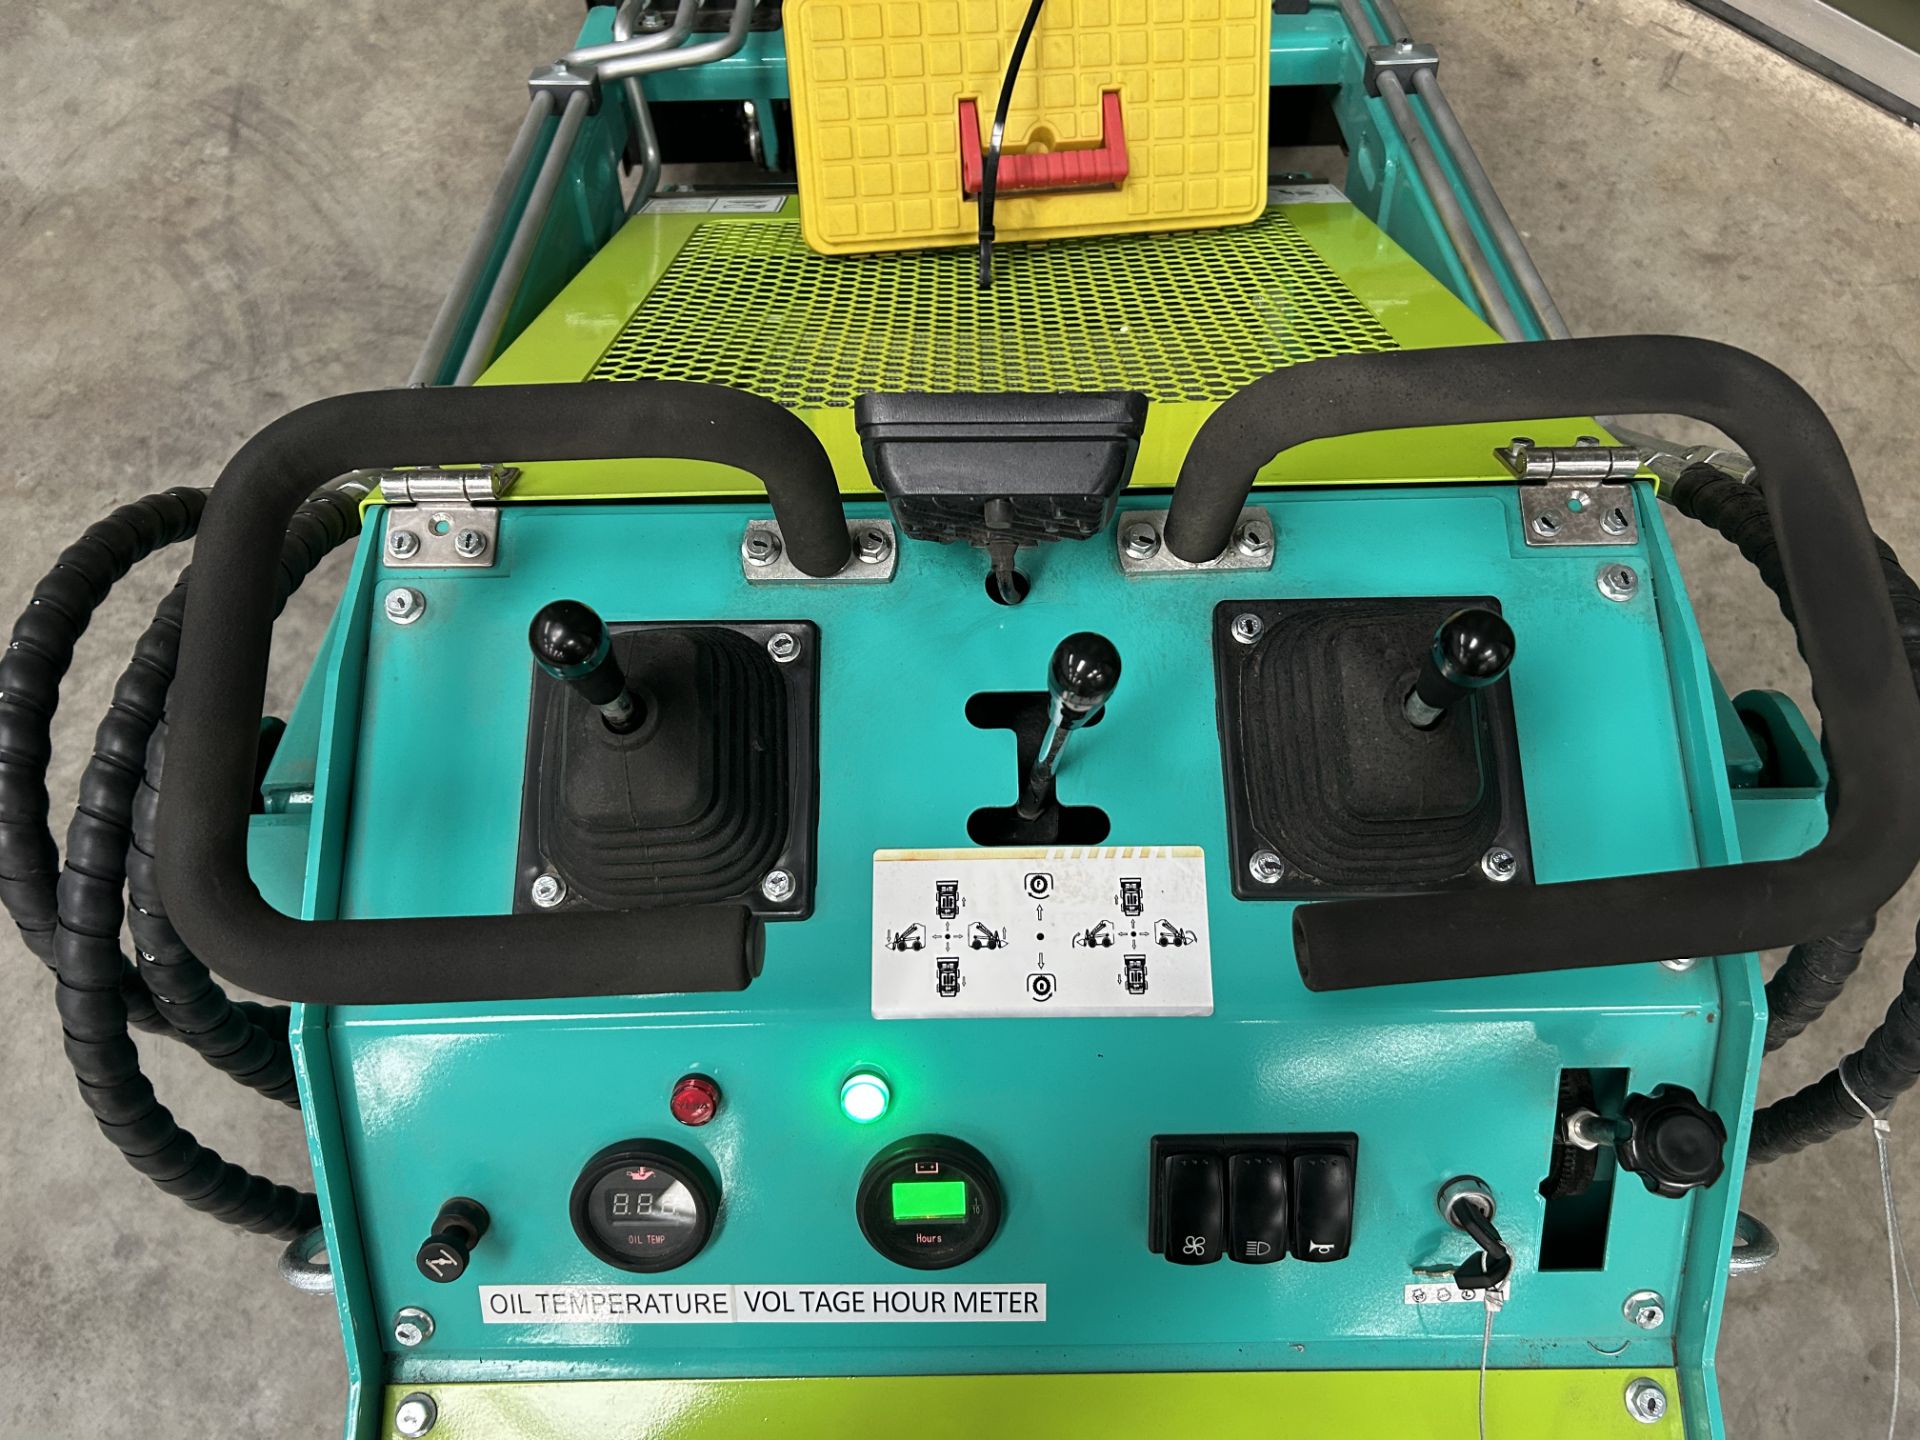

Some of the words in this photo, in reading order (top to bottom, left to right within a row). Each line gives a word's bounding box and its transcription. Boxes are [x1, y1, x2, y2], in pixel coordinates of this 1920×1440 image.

[628, 1234, 643, 1244] OIL
[647, 1234, 665, 1244] TEMP
[916, 1233, 942, 1243] Hours
[490, 1293, 531, 1314] OIL
[535, 1293, 728, 1314] TEMPERATURE
[873, 1291, 946, 1313] HOUR
[954, 1291, 1038, 1313] METER
